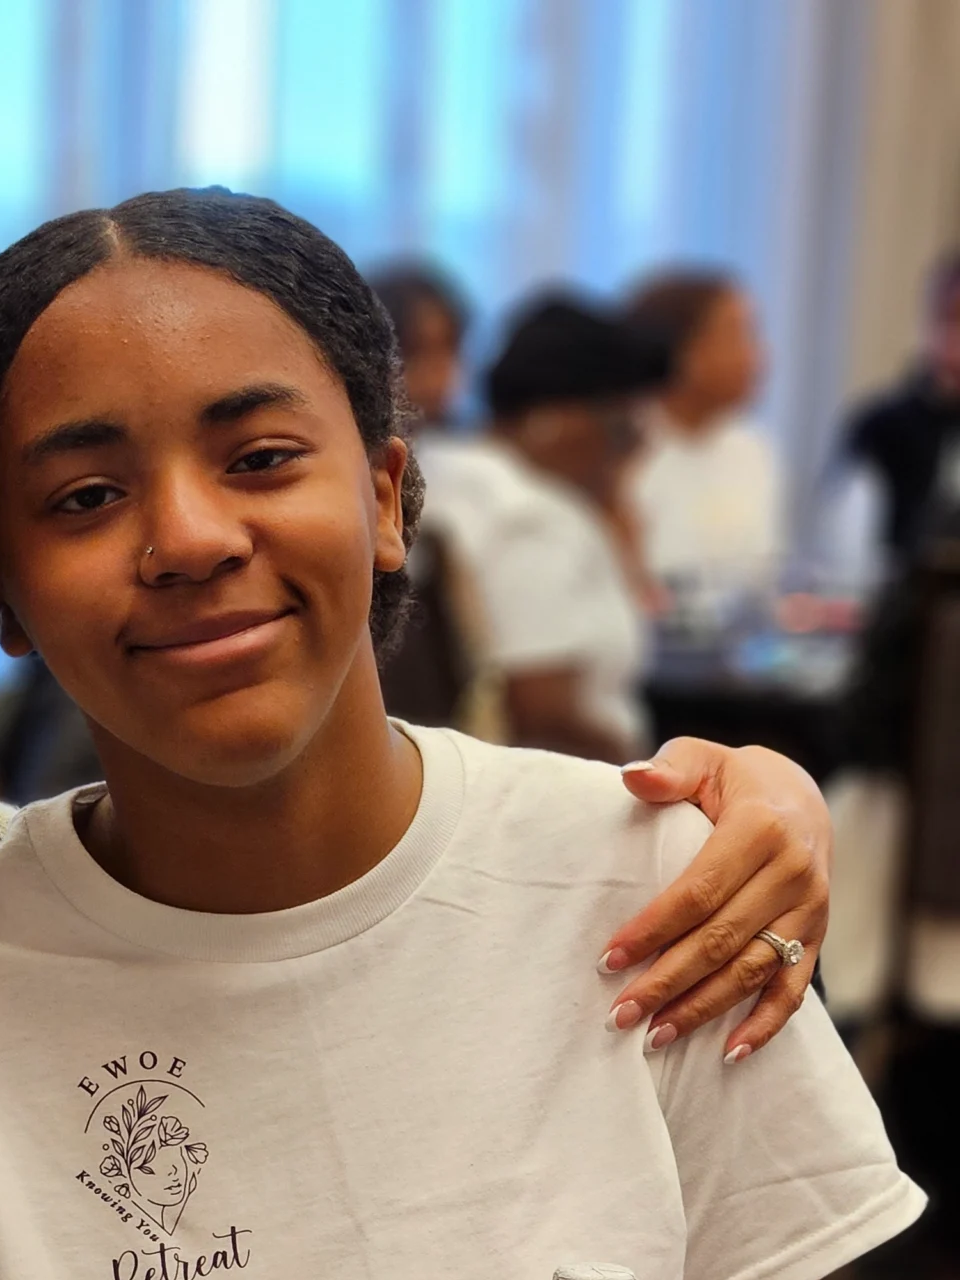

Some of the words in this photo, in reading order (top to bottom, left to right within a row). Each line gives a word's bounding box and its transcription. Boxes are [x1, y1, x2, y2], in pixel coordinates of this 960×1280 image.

[77, 1050, 187, 1097] EWOE
[75, 1169, 133, 1223] Knowing
[135, 1218, 160, 1243] You
